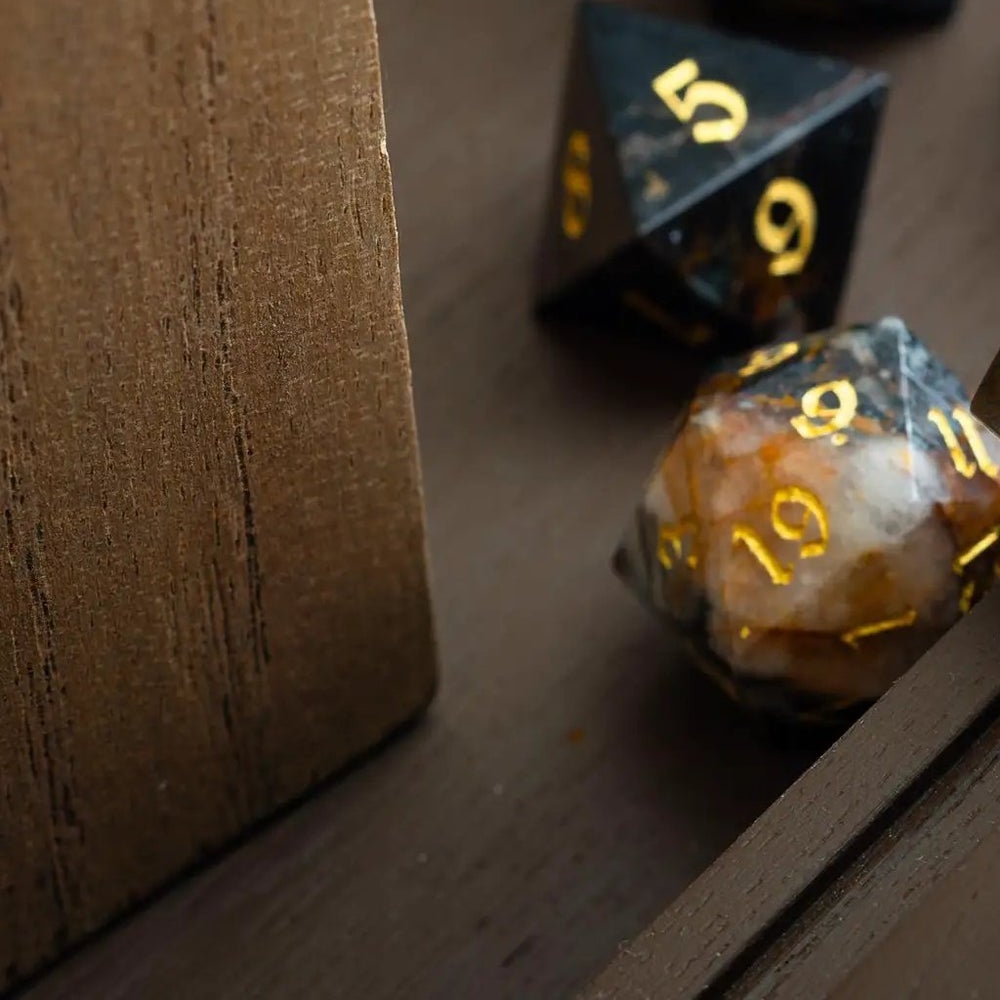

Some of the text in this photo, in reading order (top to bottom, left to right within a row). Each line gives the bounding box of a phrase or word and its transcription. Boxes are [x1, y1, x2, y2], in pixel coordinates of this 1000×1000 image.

[653, 58, 748, 144] 5
[927, 406, 999, 478] 11
[732, 485, 829, 586] 19
